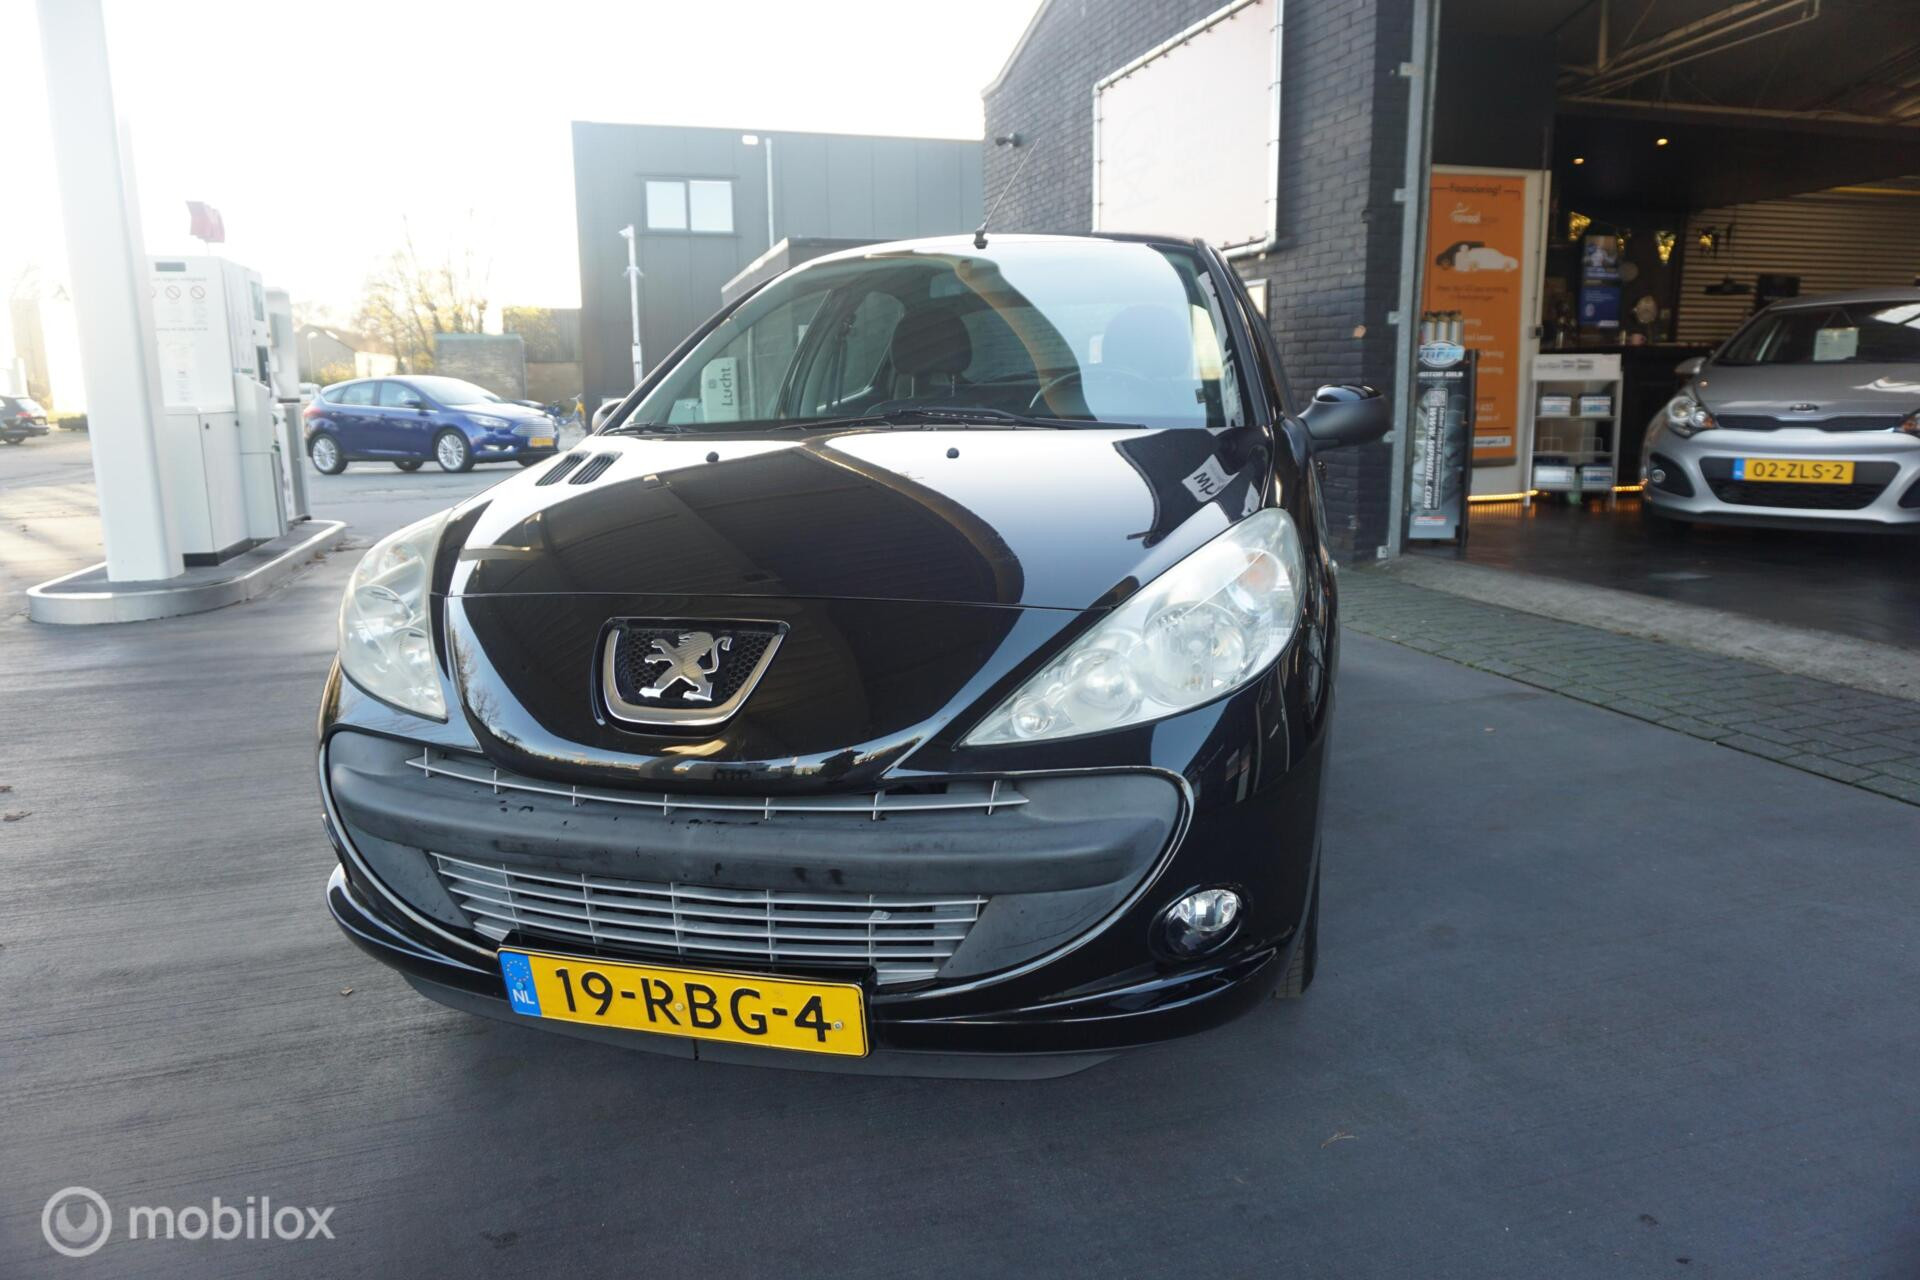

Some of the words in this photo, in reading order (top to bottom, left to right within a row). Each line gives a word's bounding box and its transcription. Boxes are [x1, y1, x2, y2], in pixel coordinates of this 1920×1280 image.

[720, 367, 733, 406] Lucht
[1424, 407, 1437, 509] WWW.MPMOIL.COM
[1753, 462, 1845, 480] 02-ZLS-2
[511, 988, 535, 1006] NL
[555, 968, 832, 1043] 19-RBG-4
